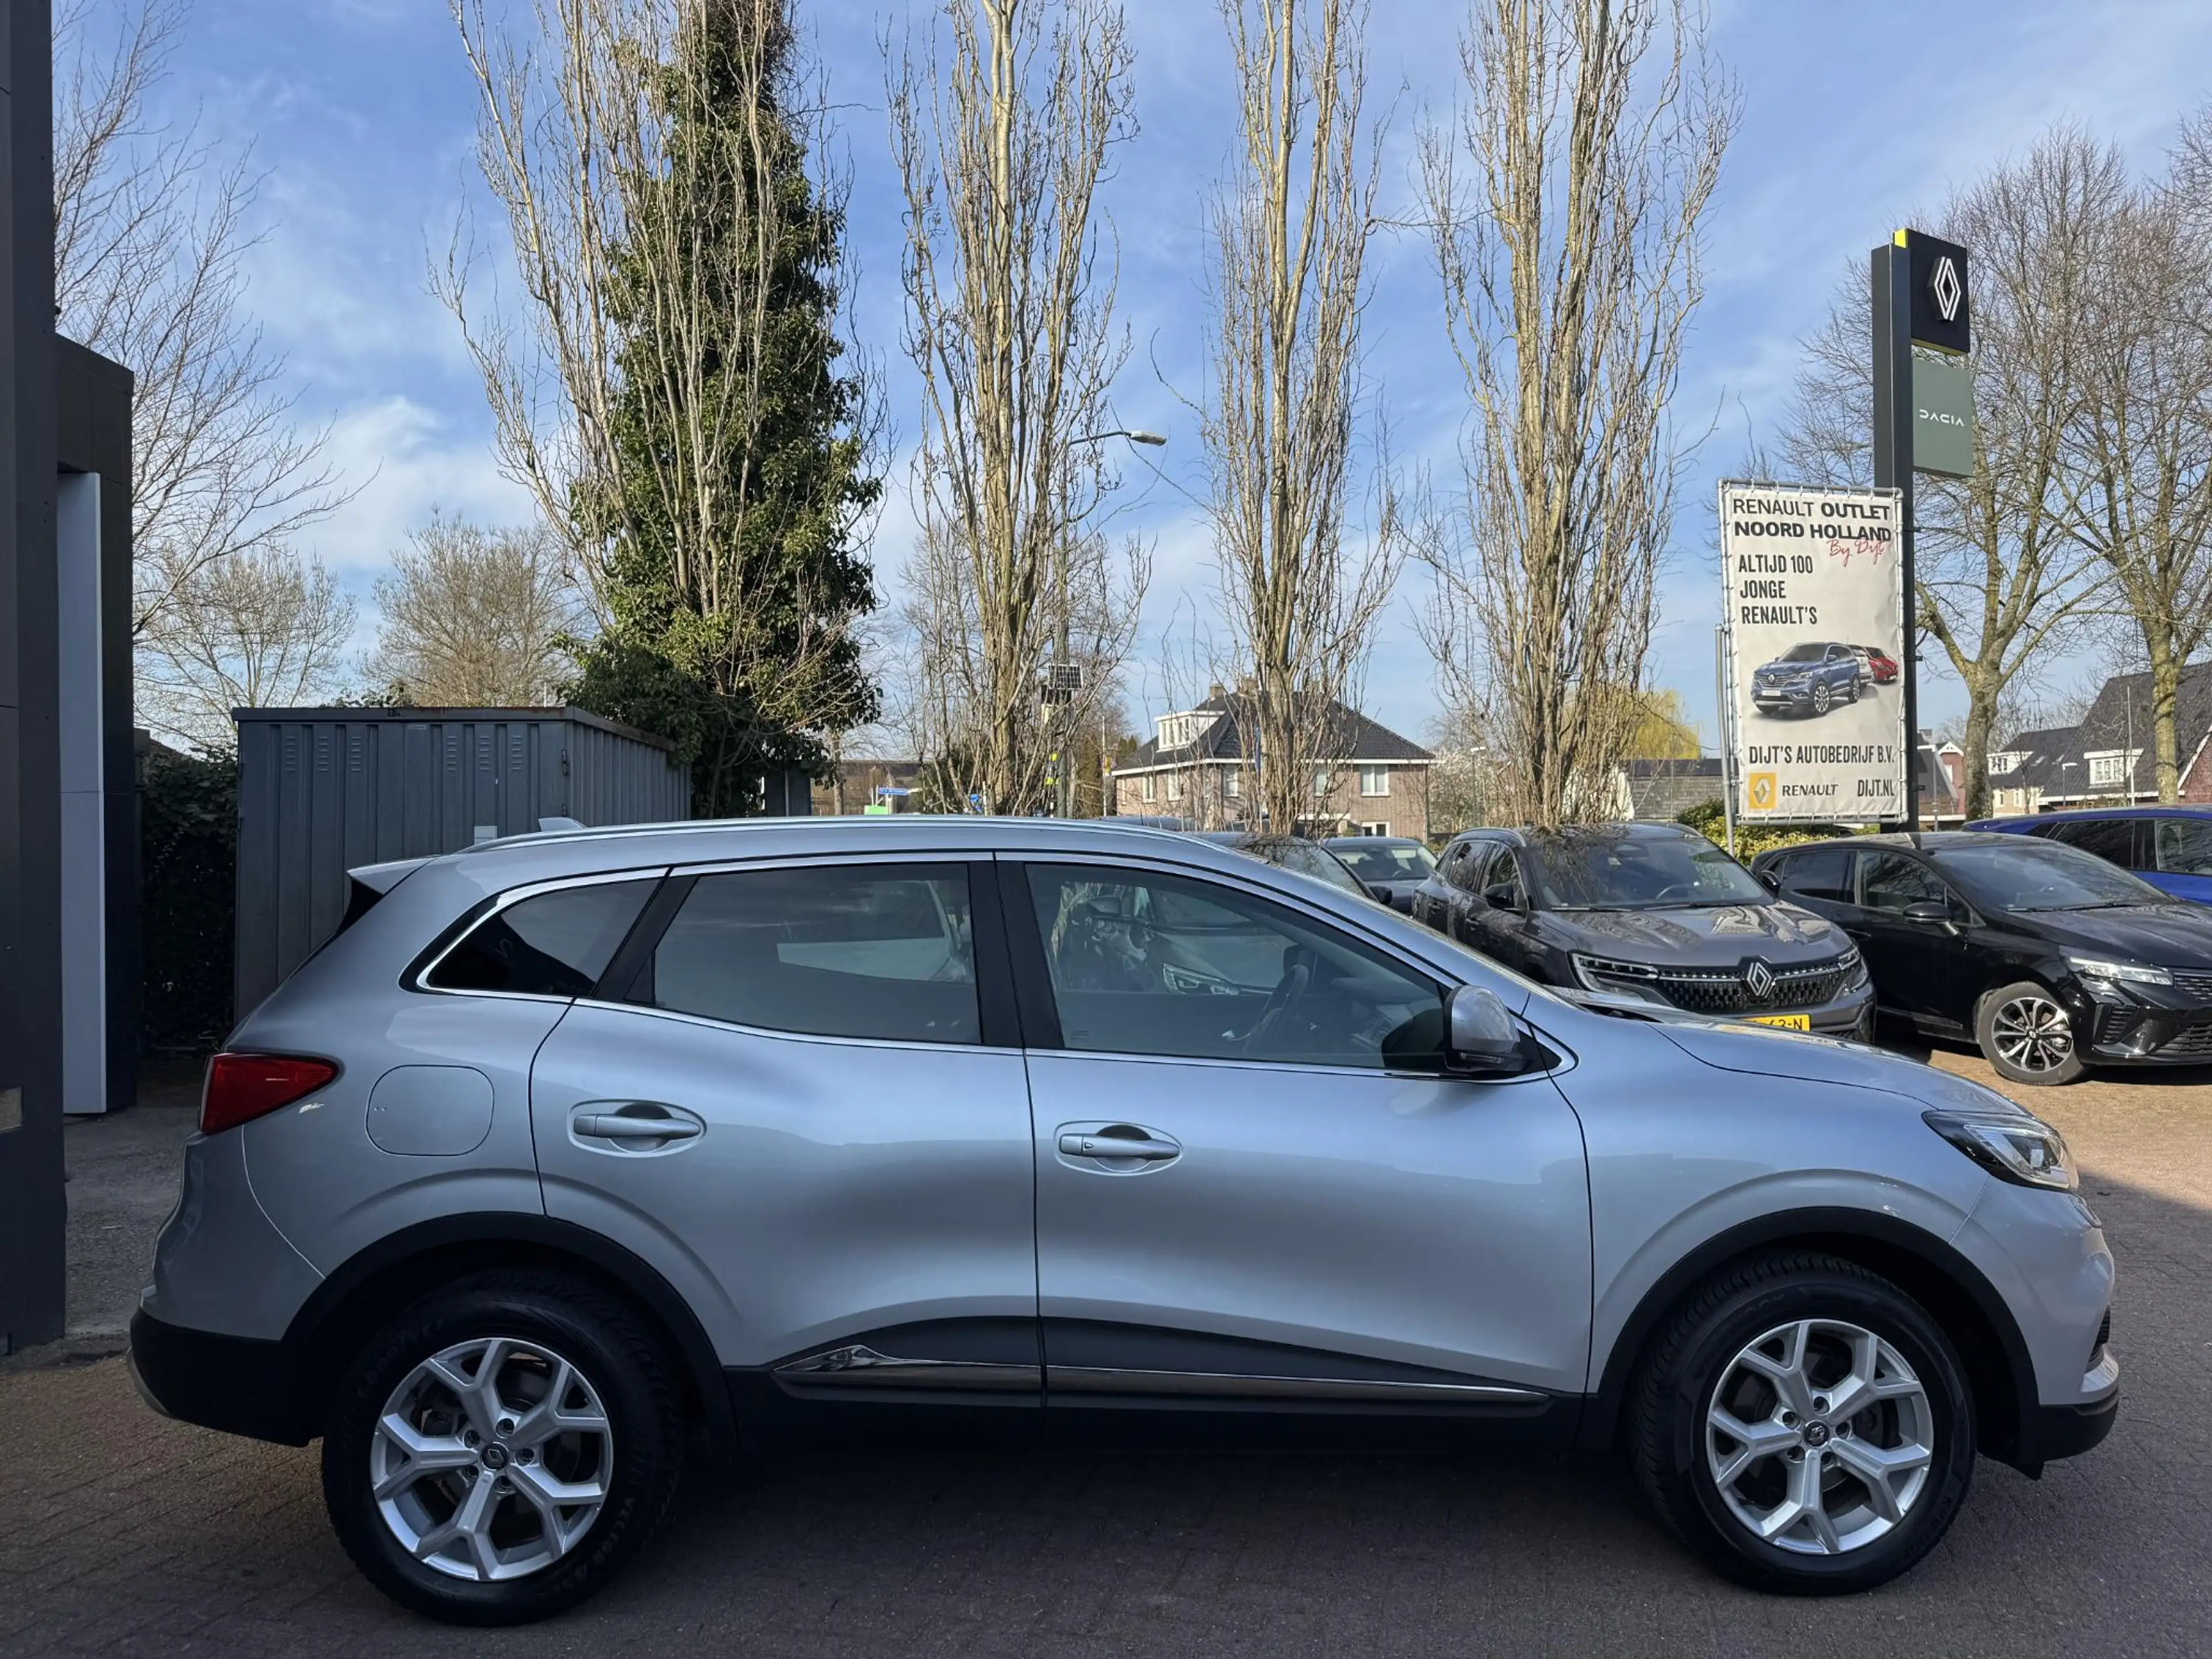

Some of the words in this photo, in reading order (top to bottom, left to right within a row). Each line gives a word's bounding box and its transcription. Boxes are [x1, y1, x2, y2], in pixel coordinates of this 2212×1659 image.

[1919, 409, 1964, 427] DACIA
[1733, 498, 1815, 517] RENAULT
[1820, 502, 1890, 520] OUTLET
[1734, 521, 1805, 537] NOORD
[1810, 524, 1892, 541] HOLLAND
[1738, 555, 1787, 573] ALTIJD
[1791, 555, 1814, 574] 100
[1740, 580, 1786, 599] JONGE
[1741, 606, 1818, 624] RENAULT'S
[1749, 745, 1792, 764] DIJT'S
[1796, 745, 1875, 764] AUTOBEDRIJF
[1878, 746, 1895, 763] B.V.
[1782, 785, 1838, 796] RENAULT
[1858, 779, 1895, 797] DIJT.NL
